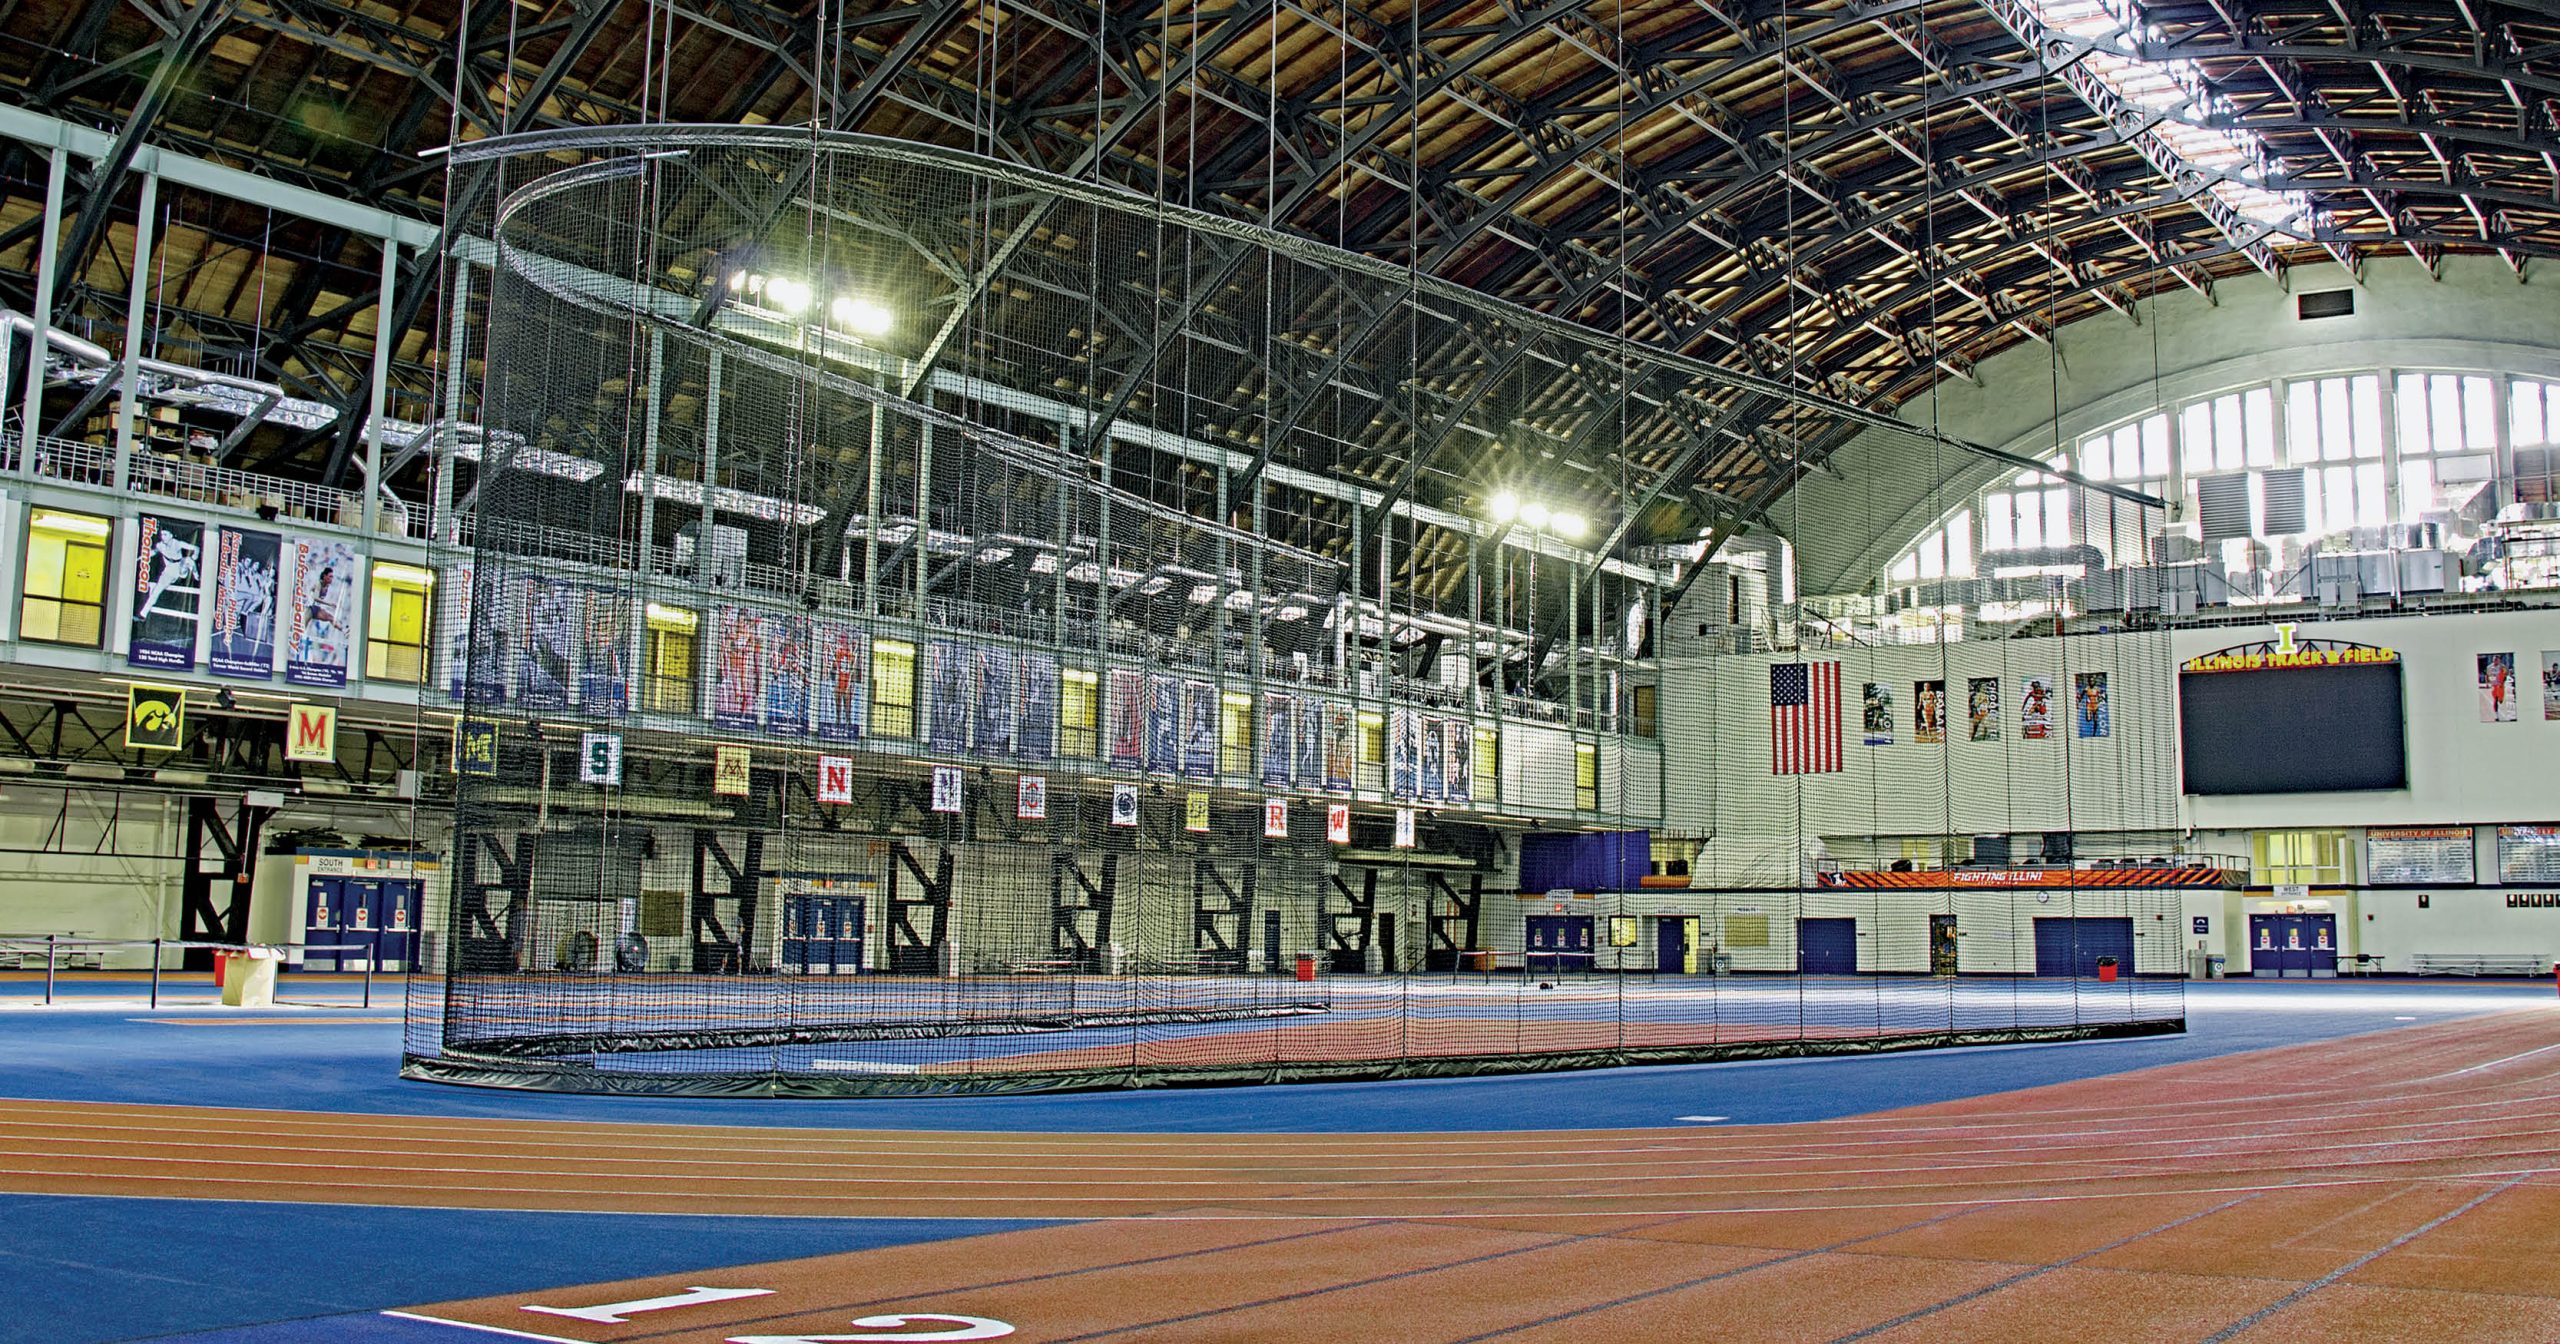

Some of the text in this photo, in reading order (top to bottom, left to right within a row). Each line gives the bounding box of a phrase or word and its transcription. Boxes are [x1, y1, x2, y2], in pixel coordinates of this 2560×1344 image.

[138, 517, 157, 593] Thomson
[214, 584, 227, 630] Mango
[289, 543, 309, 652] Buford-Bailey
[2274, 622, 2299, 655] I
[2189, 647, 2394, 671] ILLINOIS TRACK & FIELD
[295, 710, 328, 750] M
[465, 732, 492, 762] M
[591, 741, 609, 775] S
[720, 759, 745, 778] M
[827, 766, 846, 792] N
[1268, 805, 1284, 830] R
[1332, 810, 1345, 832] W
[319, 858, 343, 867] SOUTH
[1954, 871, 2043, 881] FIGHTING ILLINI
[518, 1286, 778, 1325] 1
[724, 1313, 1016, 1344] 2
